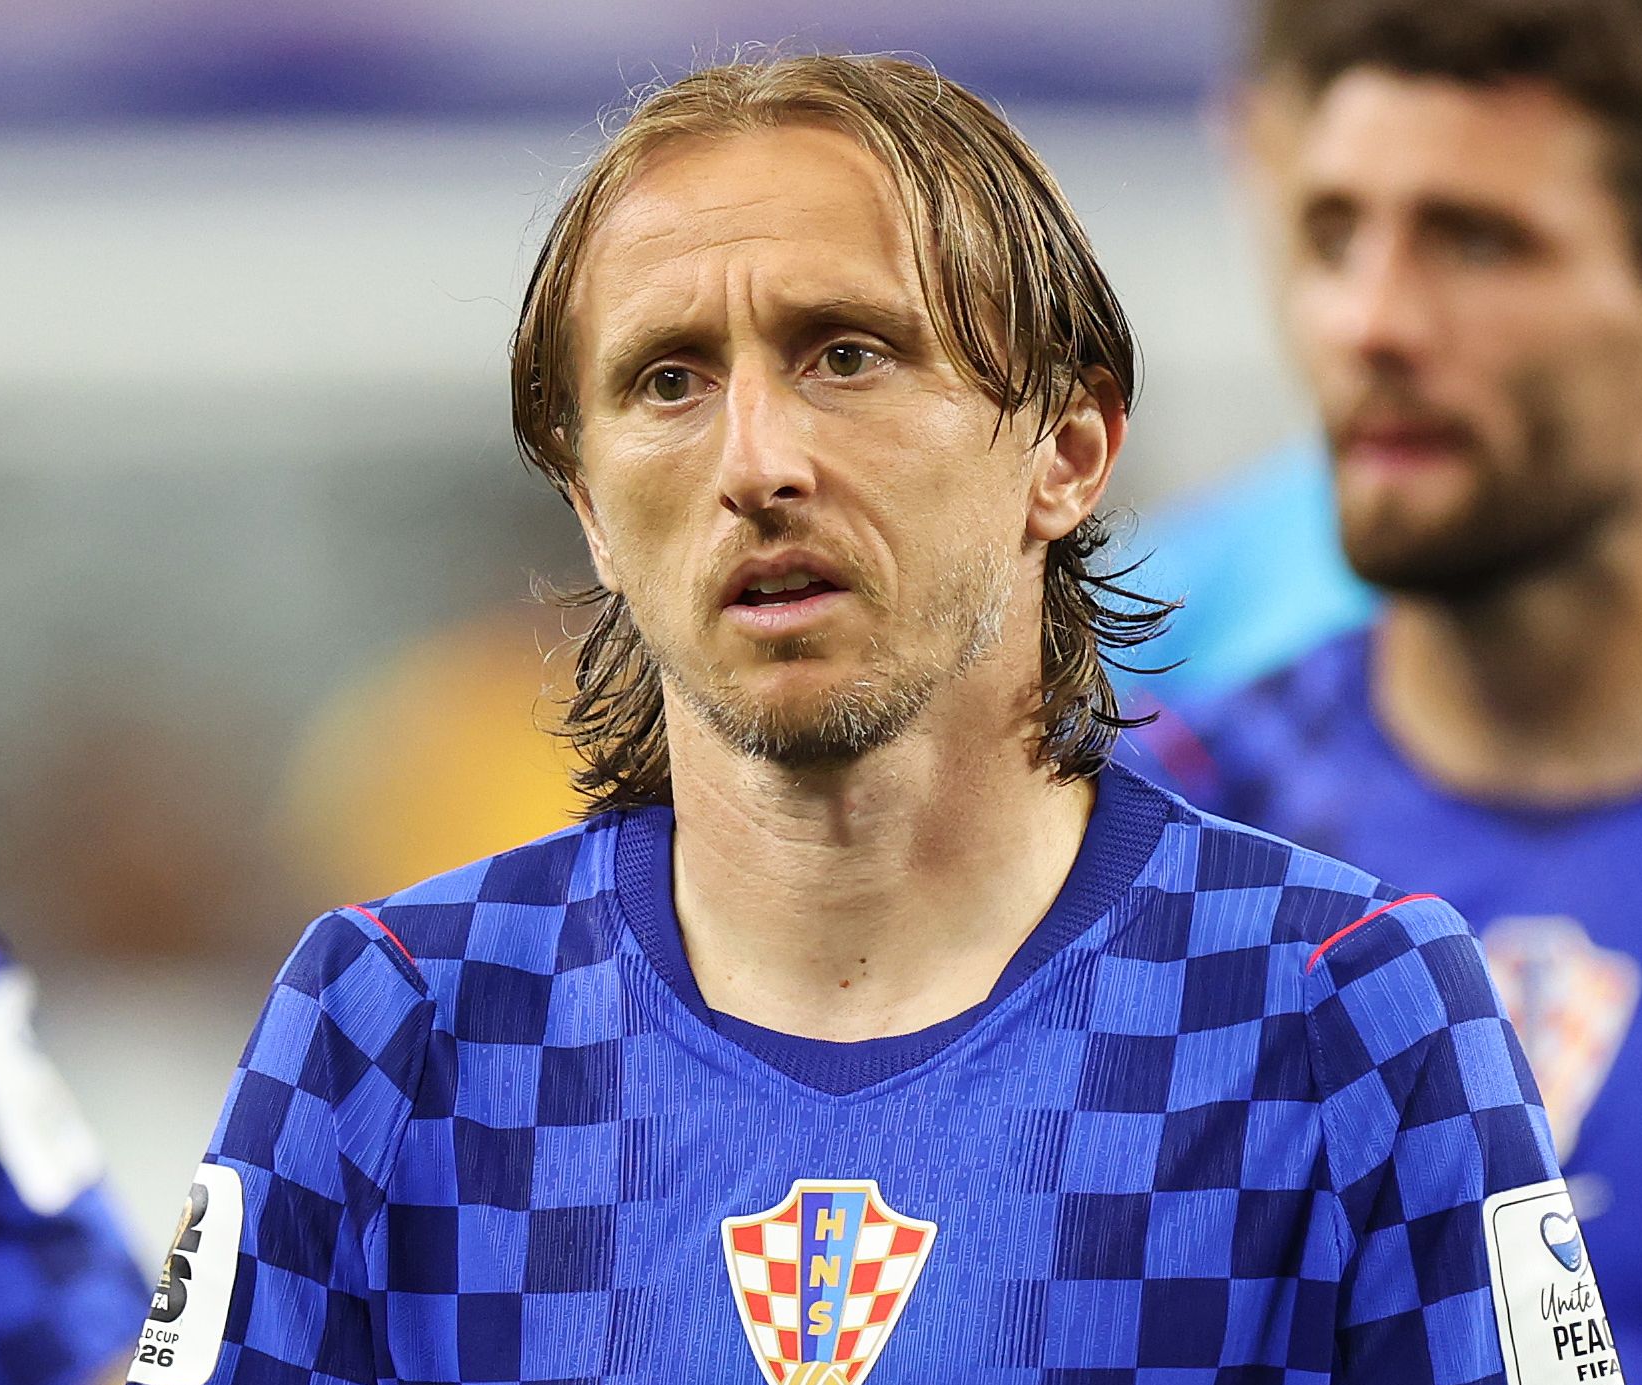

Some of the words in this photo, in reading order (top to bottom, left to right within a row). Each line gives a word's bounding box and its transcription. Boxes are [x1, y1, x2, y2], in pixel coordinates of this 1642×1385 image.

[807, 1208, 846, 1335] HNS
[1541, 1281, 1595, 1323] Unite
[156, 1330, 179, 1344] CUP
[138, 1344, 175, 1368] 26
